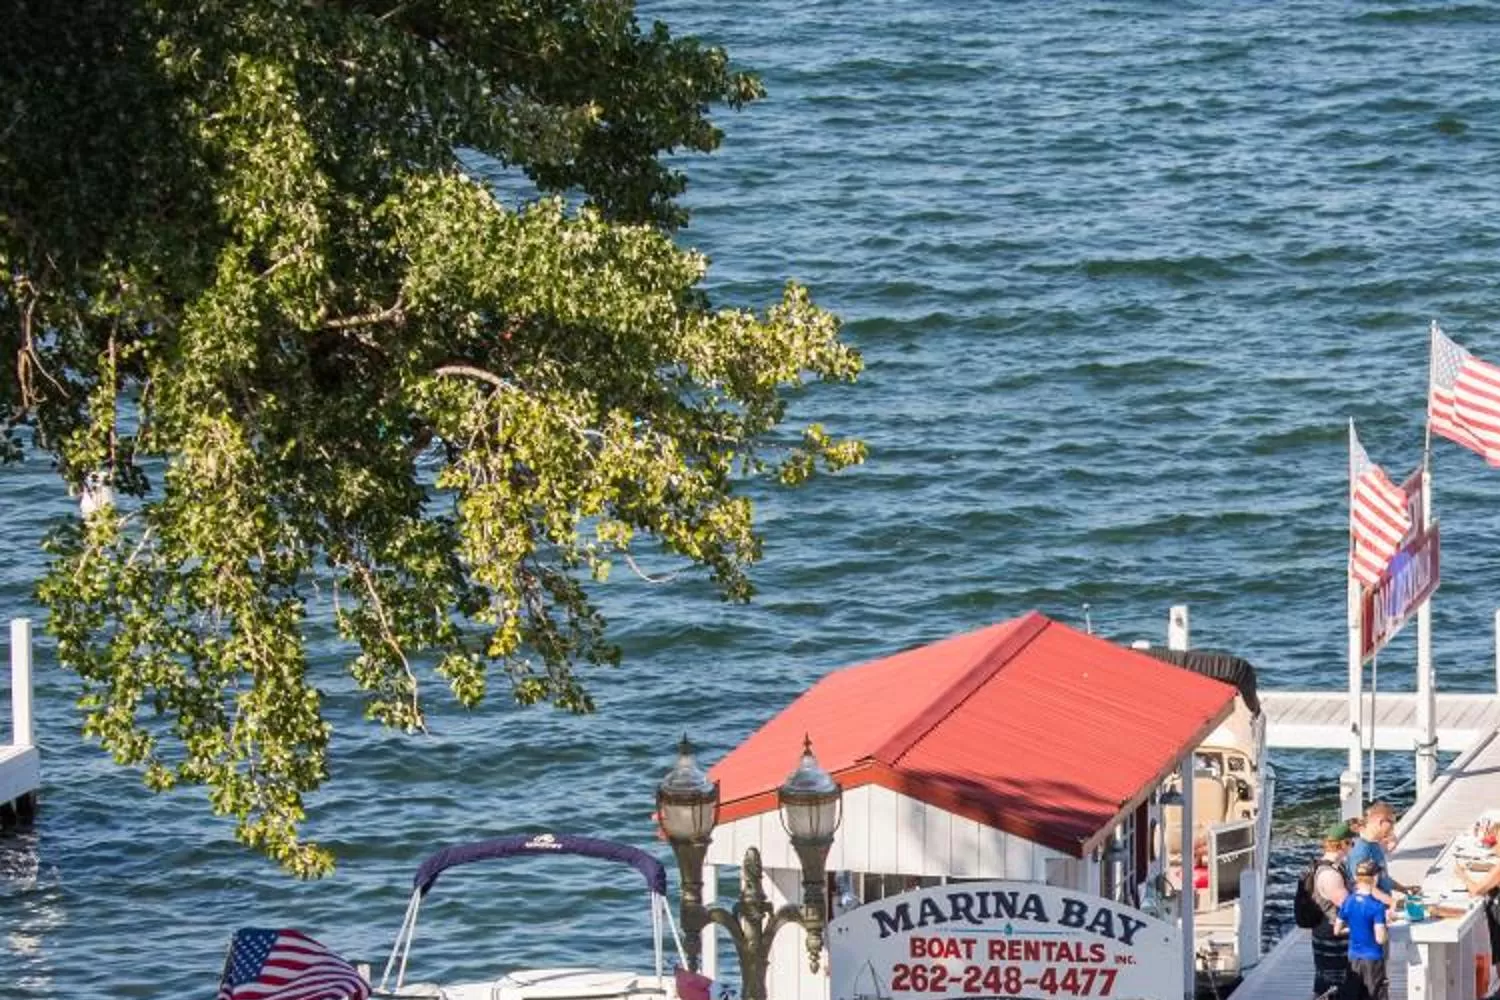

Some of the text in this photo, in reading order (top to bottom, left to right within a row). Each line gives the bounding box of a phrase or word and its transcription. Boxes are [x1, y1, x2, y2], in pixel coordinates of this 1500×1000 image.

[872, 891, 1147, 946] MARINA BAY
[909, 937, 1137, 965] BOAT RENTALS INC.
[891, 963, 1118, 996] 262-248-4477
